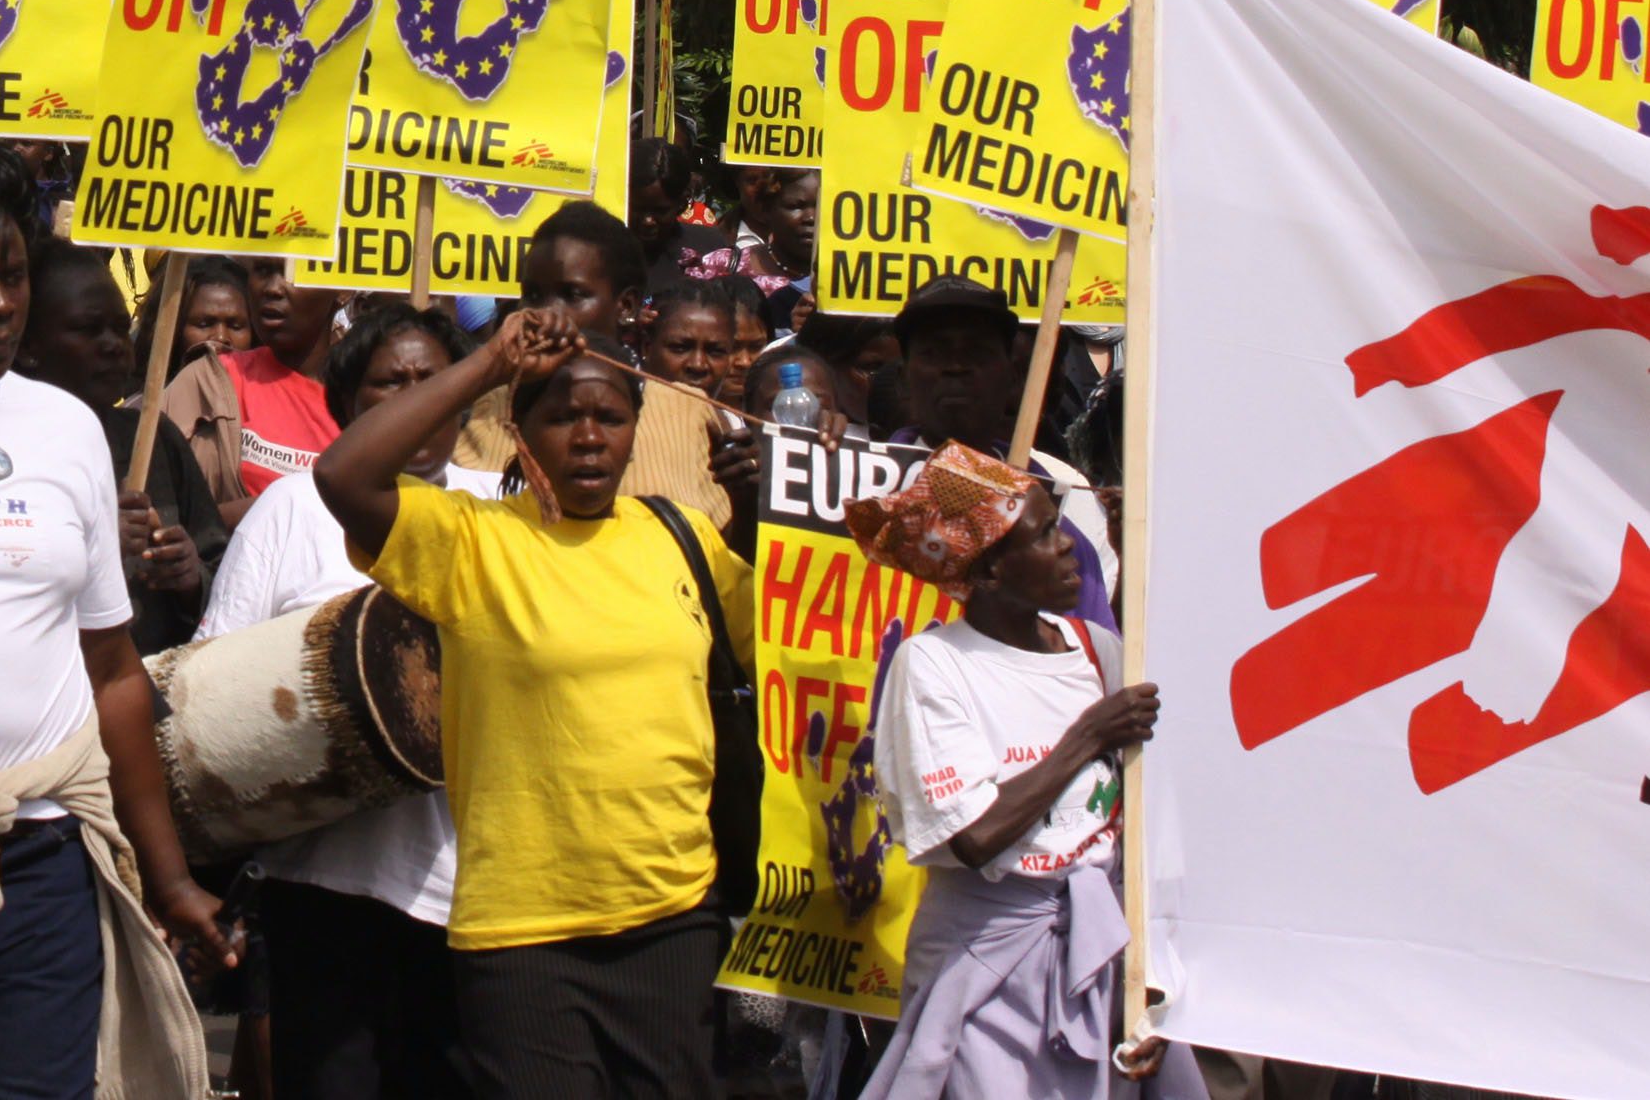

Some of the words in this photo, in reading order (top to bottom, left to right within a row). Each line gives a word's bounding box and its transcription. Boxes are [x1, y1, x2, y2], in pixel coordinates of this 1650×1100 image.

[839, 16, 945, 113] OF
[737, 84, 802, 119] OUR
[940, 63, 1040, 136] OUR
[98, 114, 173, 171] OUR
[347, 108, 510, 170] DICINE
[344, 170, 406, 220] UR
[922, 124, 1128, 227] MEDICIN
[81, 177, 273, 240] MEDICINE
[833, 191, 932, 244] OUR
[241, 432, 293, 463] Women
[764, 668, 867, 784] OFF
[1003, 746, 1038, 764] JUA
[921, 765, 957, 787] WAD
[759, 861, 815, 920] OUR
[726, 922, 864, 997] MEDICINE
